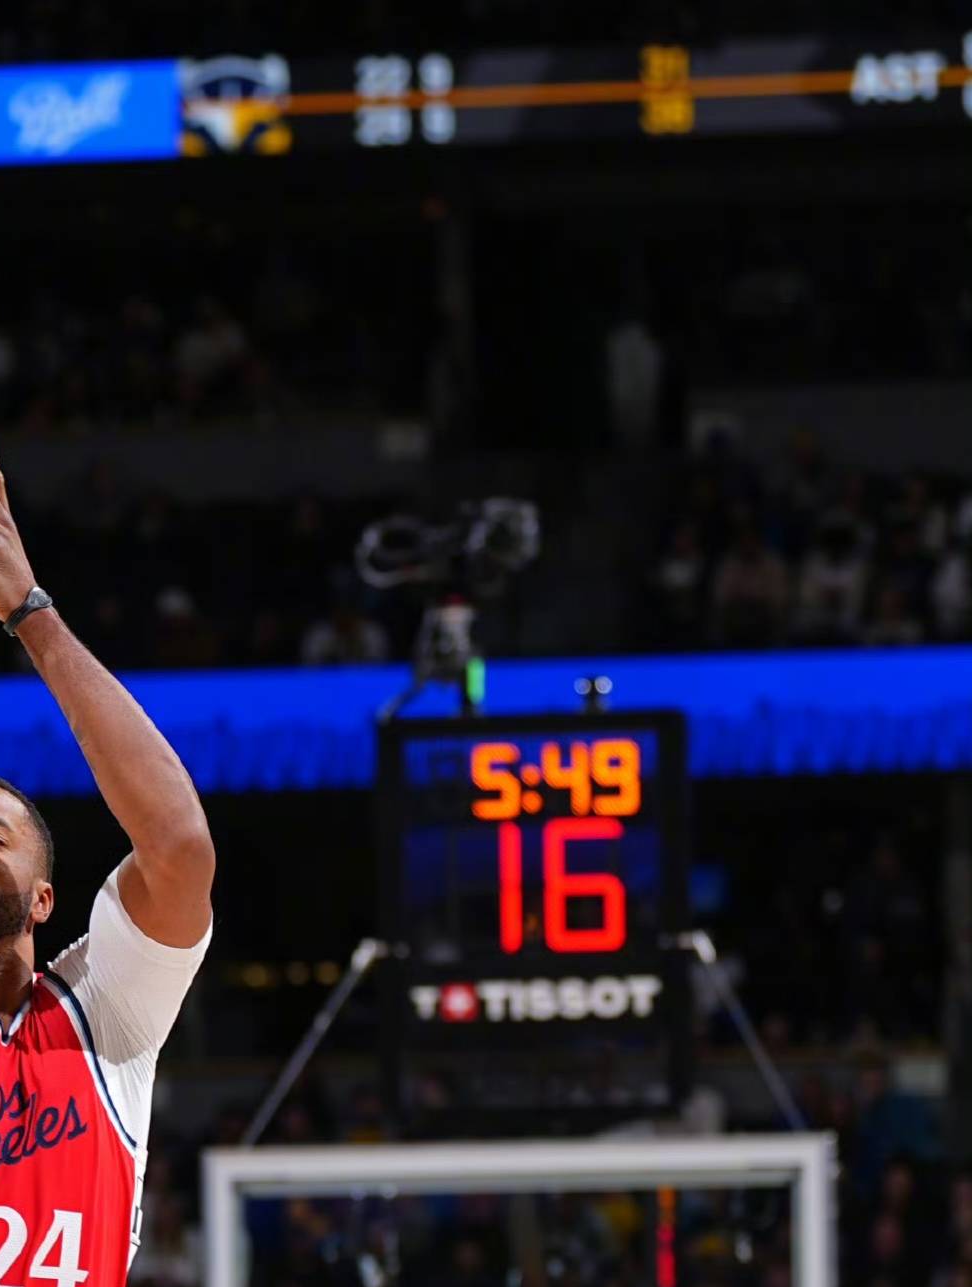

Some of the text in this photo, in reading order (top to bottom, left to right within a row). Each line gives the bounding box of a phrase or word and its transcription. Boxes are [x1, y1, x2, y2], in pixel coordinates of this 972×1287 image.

[471, 739, 641, 820] 5:49
[498, 818, 626, 955] 16
[480, 976, 661, 1021] TISSOT
